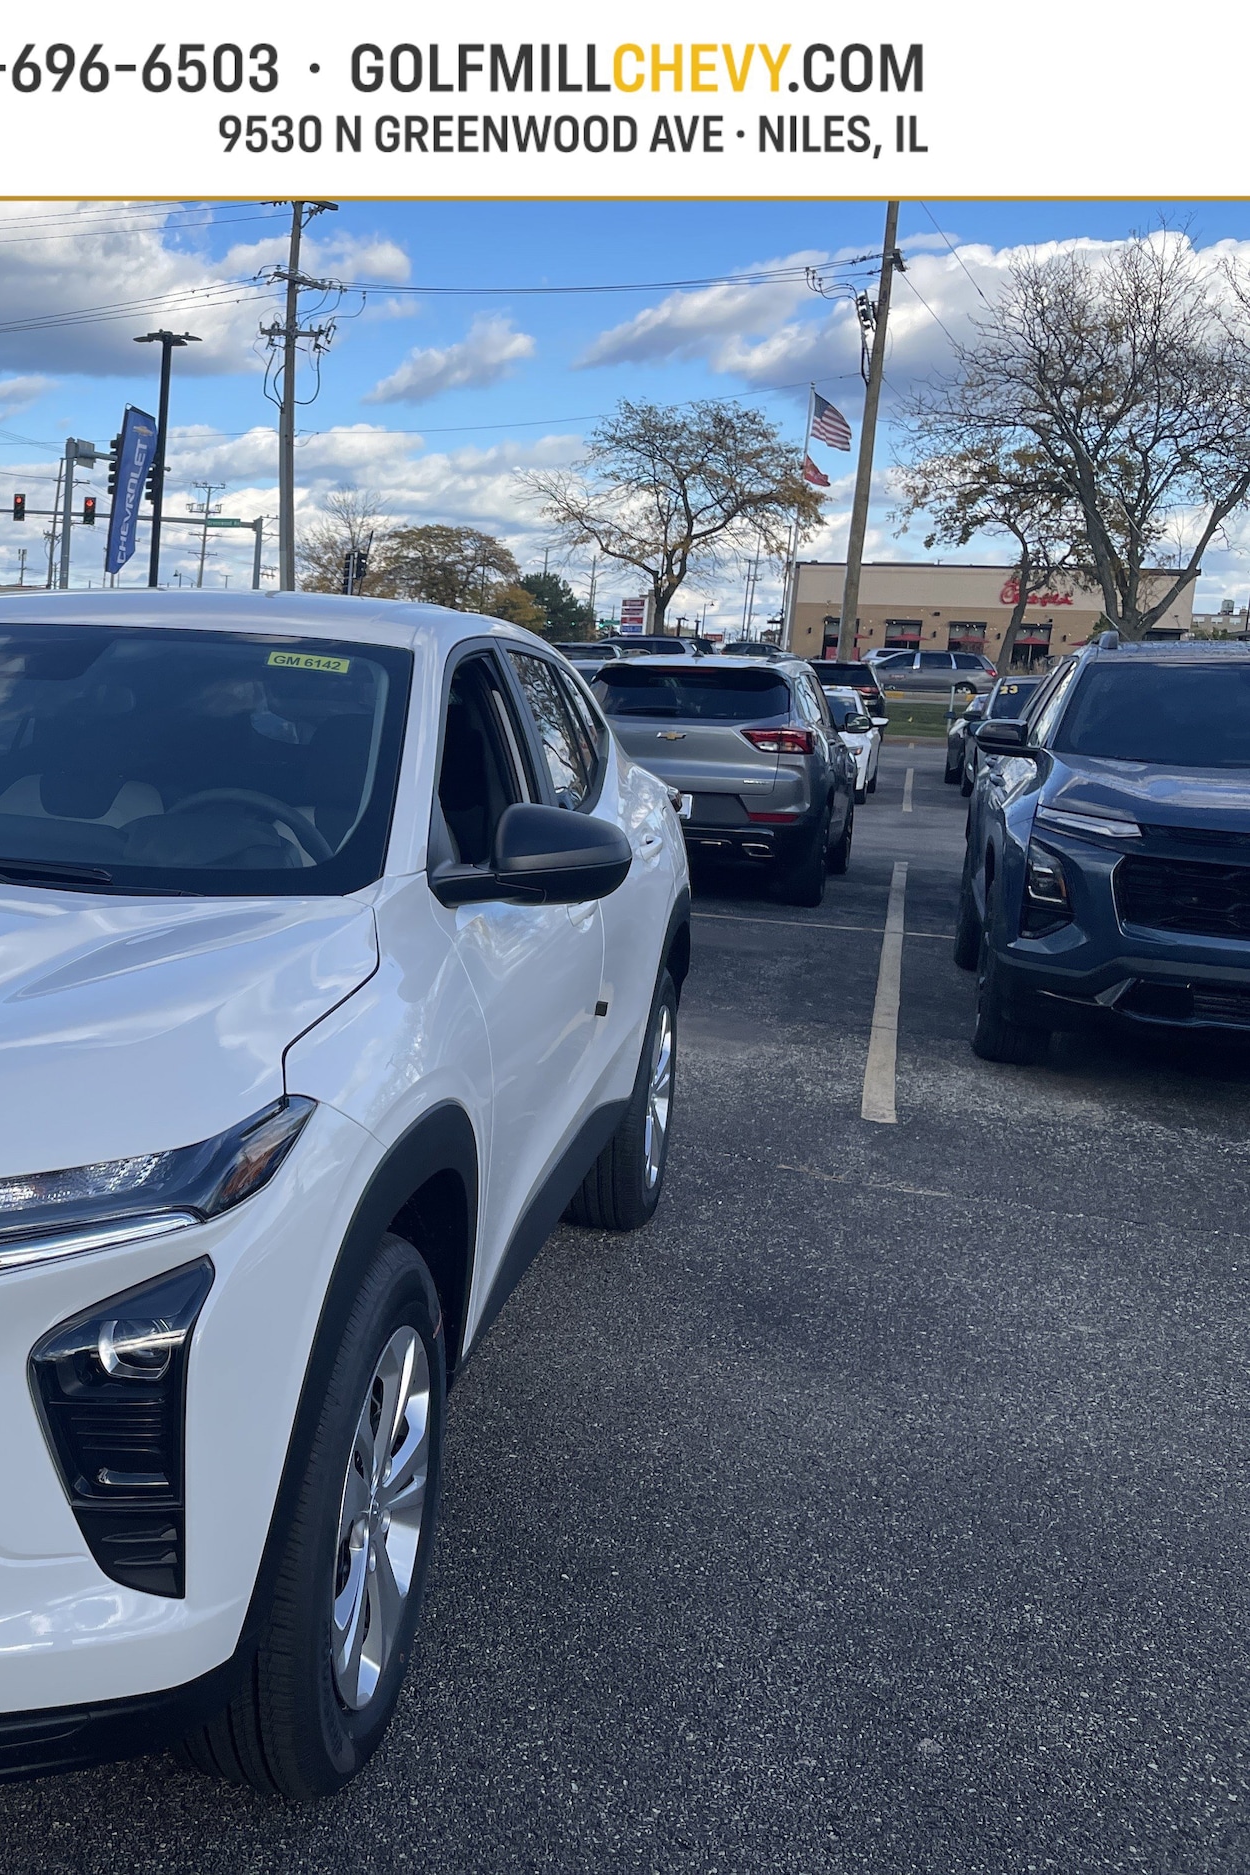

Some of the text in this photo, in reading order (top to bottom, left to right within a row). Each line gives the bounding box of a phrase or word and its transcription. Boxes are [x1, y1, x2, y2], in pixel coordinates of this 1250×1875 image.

[117, 439, 148, 564] CHEVROLET
[273, 655, 341, 671] GM 6142
